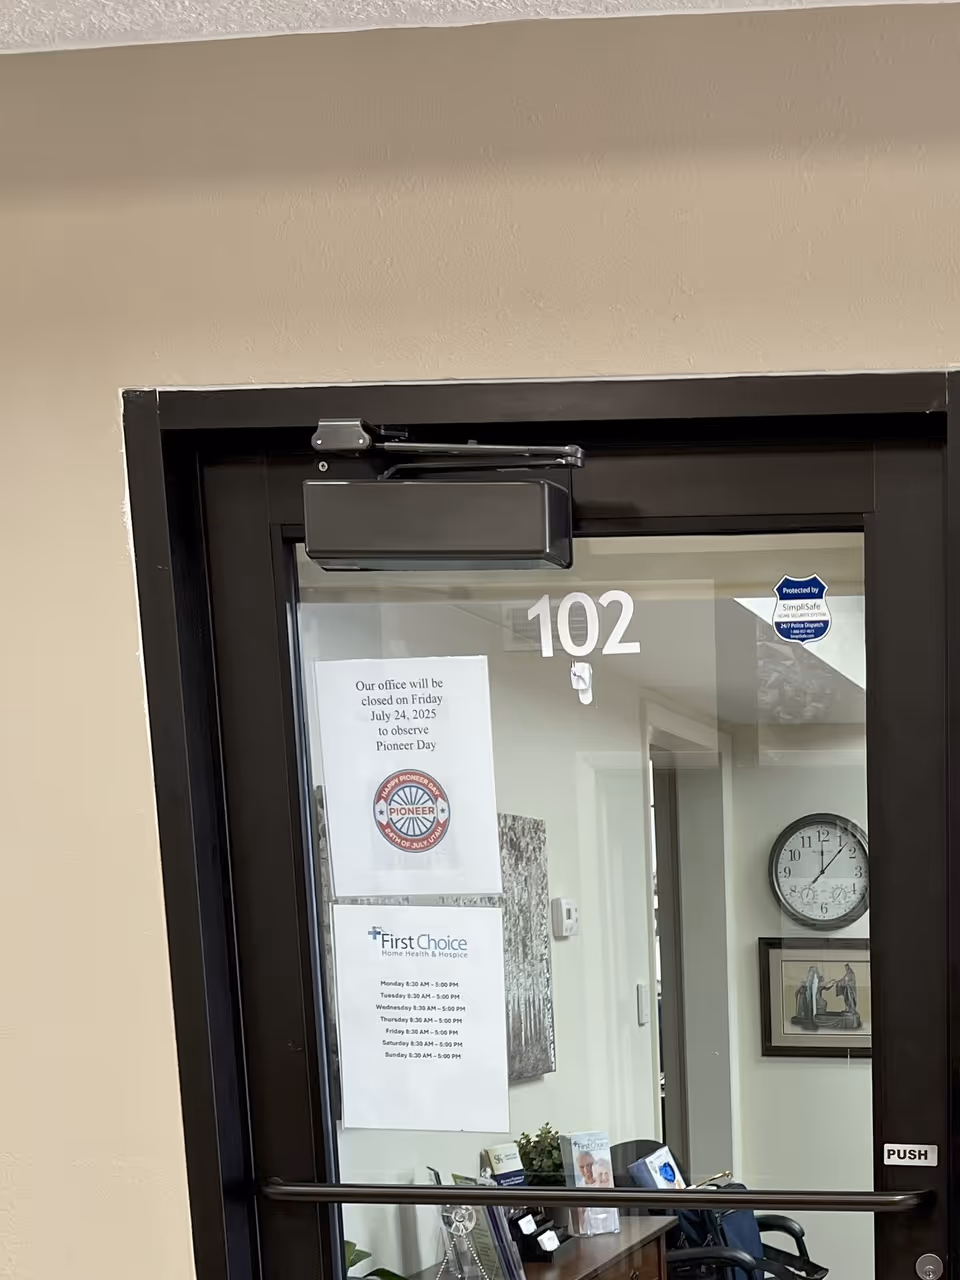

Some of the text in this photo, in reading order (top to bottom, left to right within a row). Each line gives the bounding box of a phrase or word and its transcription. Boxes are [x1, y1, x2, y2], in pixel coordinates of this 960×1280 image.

[811, 586, 819, 594] by
[783, 603, 820, 611] SimpliSafe
[527, 589, 641, 658] 102
[355, 677, 444, 692] Our office will be
[361, 692, 443, 707] closed on Friday
[370, 708, 437, 724] July 24, 2025
[377, 724, 429, 736] to observe
[376, 739, 437, 752] Pioneer Day
[381, 774, 440, 798] HAPPY PIONEER DAY
[388, 806, 436, 817] PIONEER
[384, 827, 401, 844] 24TH
[400, 839, 411, 848] OF
[428, 826, 443, 844] UTAH
[800, 835, 813, 849] 11
[815, 829, 831, 843] 12
[788, 848, 802, 862] 10
[848, 846, 858, 860] 2
[783, 866, 792, 879] 9
[854, 865, 864, 879] 3
[788, 885, 797, 898] 8
[820, 902, 829, 915] 6
[381, 933, 468, 950] First Choice
[405, 950, 430, 959] Health
[431, 950, 437, 958] &
[438, 951, 468, 959] Hospice
[380, 980, 405, 988] Monday
[376, 1004, 412, 1012] Wednesday
[380, 1016, 409, 1024] Thursday
[385, 1028, 405, 1036] Friday
[382, 1040, 410, 1048] Saturday
[886, 1148, 929, 1161] PUSH
